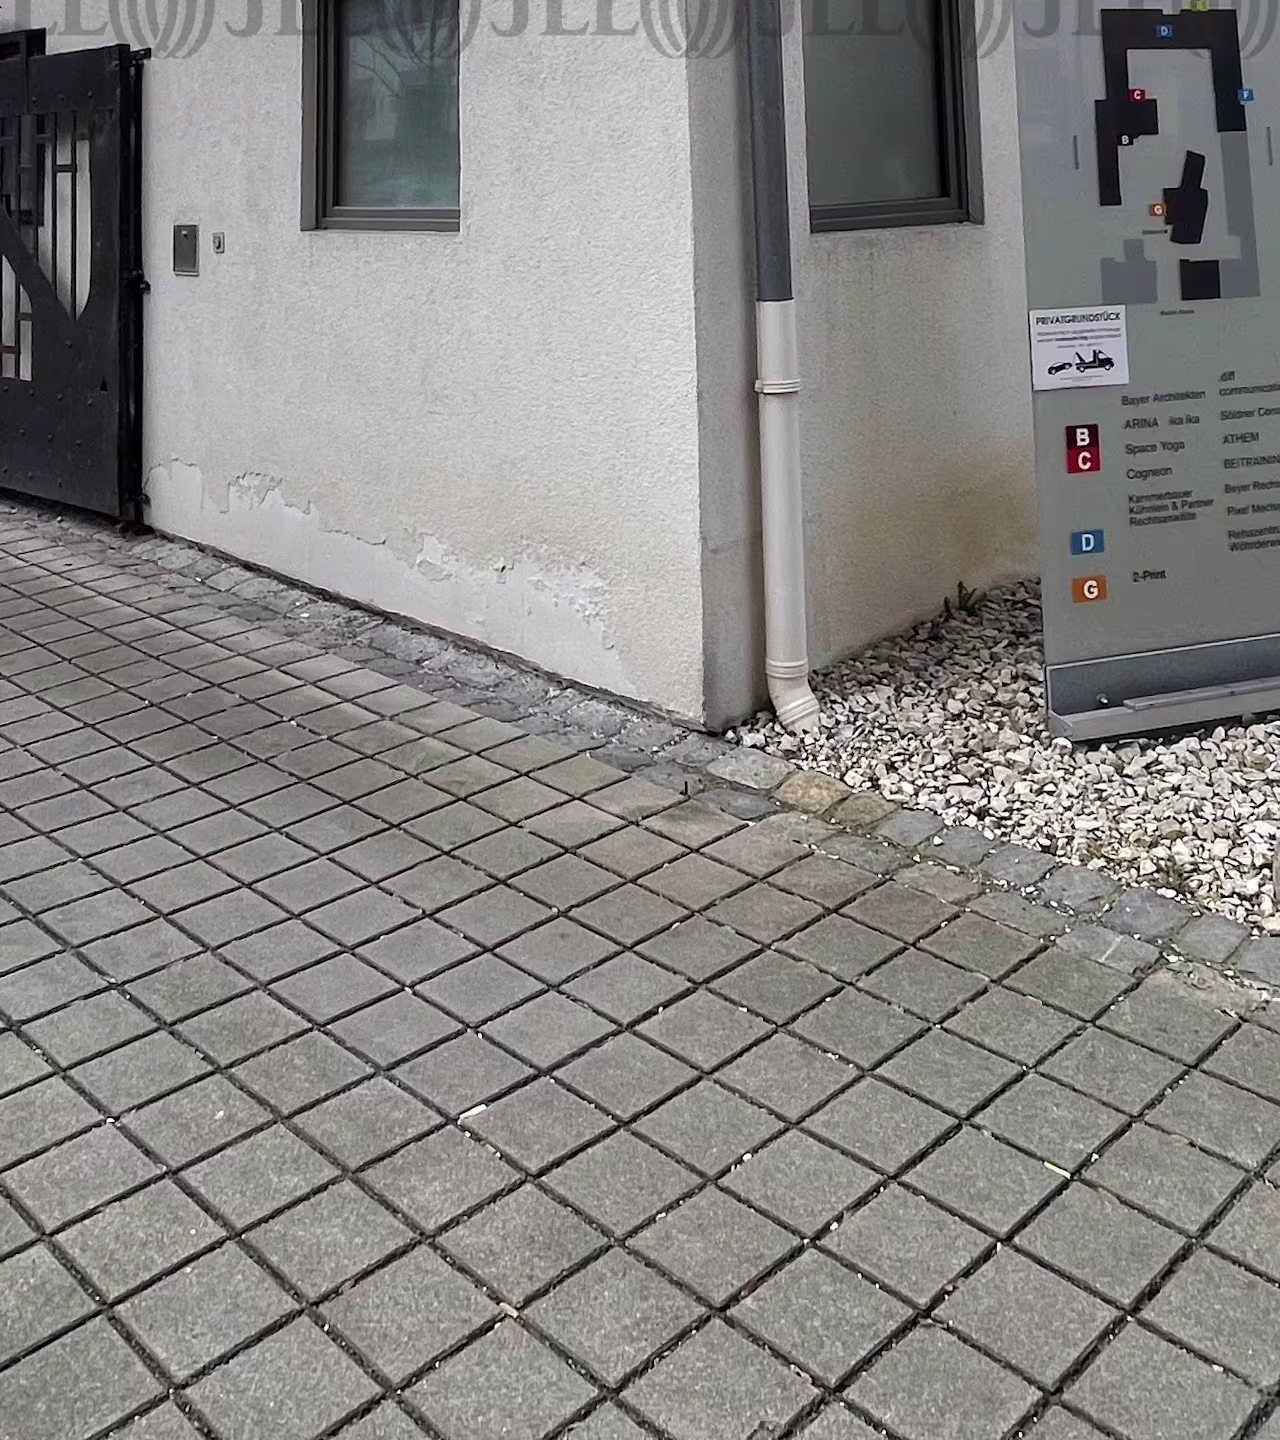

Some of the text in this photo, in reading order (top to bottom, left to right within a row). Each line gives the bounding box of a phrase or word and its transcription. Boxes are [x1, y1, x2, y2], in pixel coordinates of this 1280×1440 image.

[1036, 311, 1121, 325] PRIVATGRUNDSTÜCK
[1125, 418, 1159, 430] ARINA
[1076, 428, 1089, 446] B
[1223, 432, 1260, 445] ATHEM
[1125, 441, 1185, 457] Space Yoga
[1078, 451, 1091, 470] C
[1081, 534, 1094, 551] D
[1133, 570, 1167, 583] 2-Print
[1083, 580, 1098, 599] G
